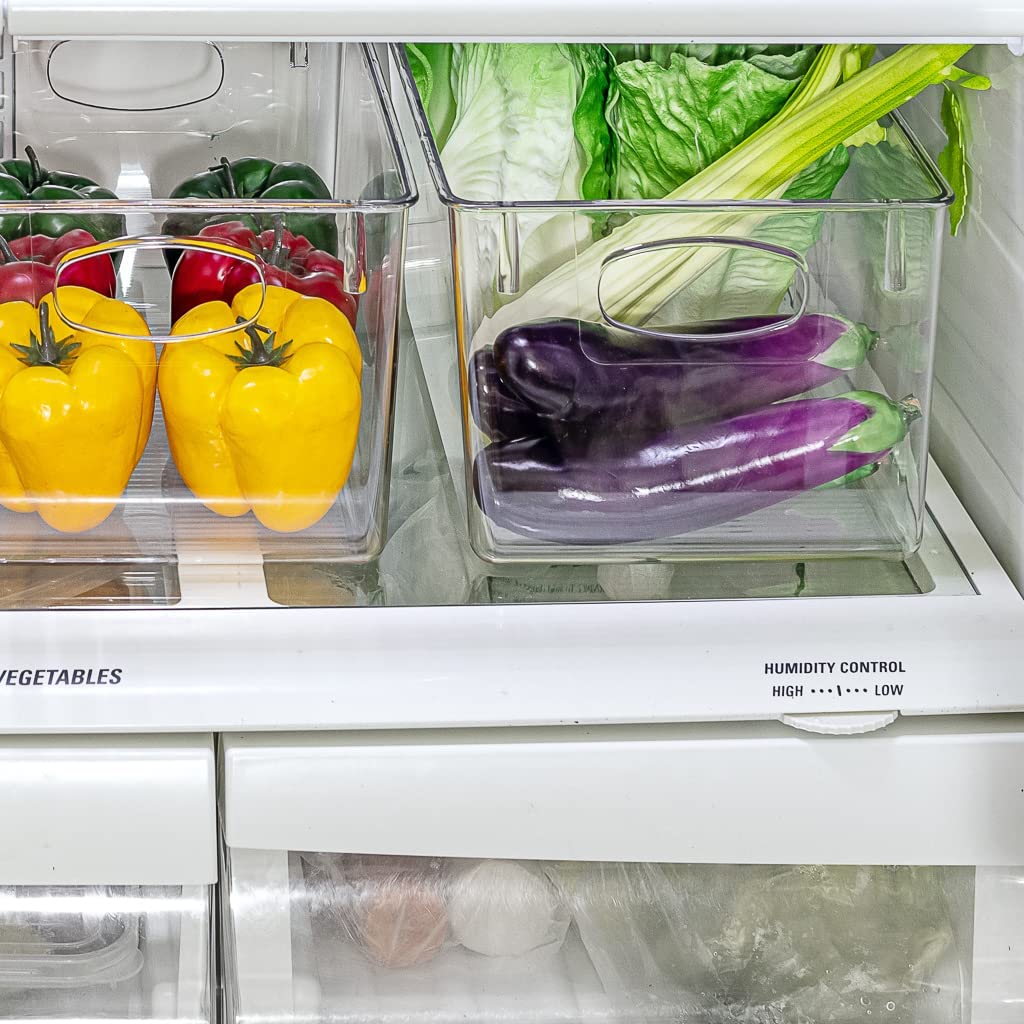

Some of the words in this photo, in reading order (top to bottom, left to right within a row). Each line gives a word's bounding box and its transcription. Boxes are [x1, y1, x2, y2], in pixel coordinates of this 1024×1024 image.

[764, 662, 836, 675] HUMIDITY
[840, 661, 906, 674] CONTROL
[772, 685, 804, 697] HIGH
[875, 684, 904, 696] LOW
